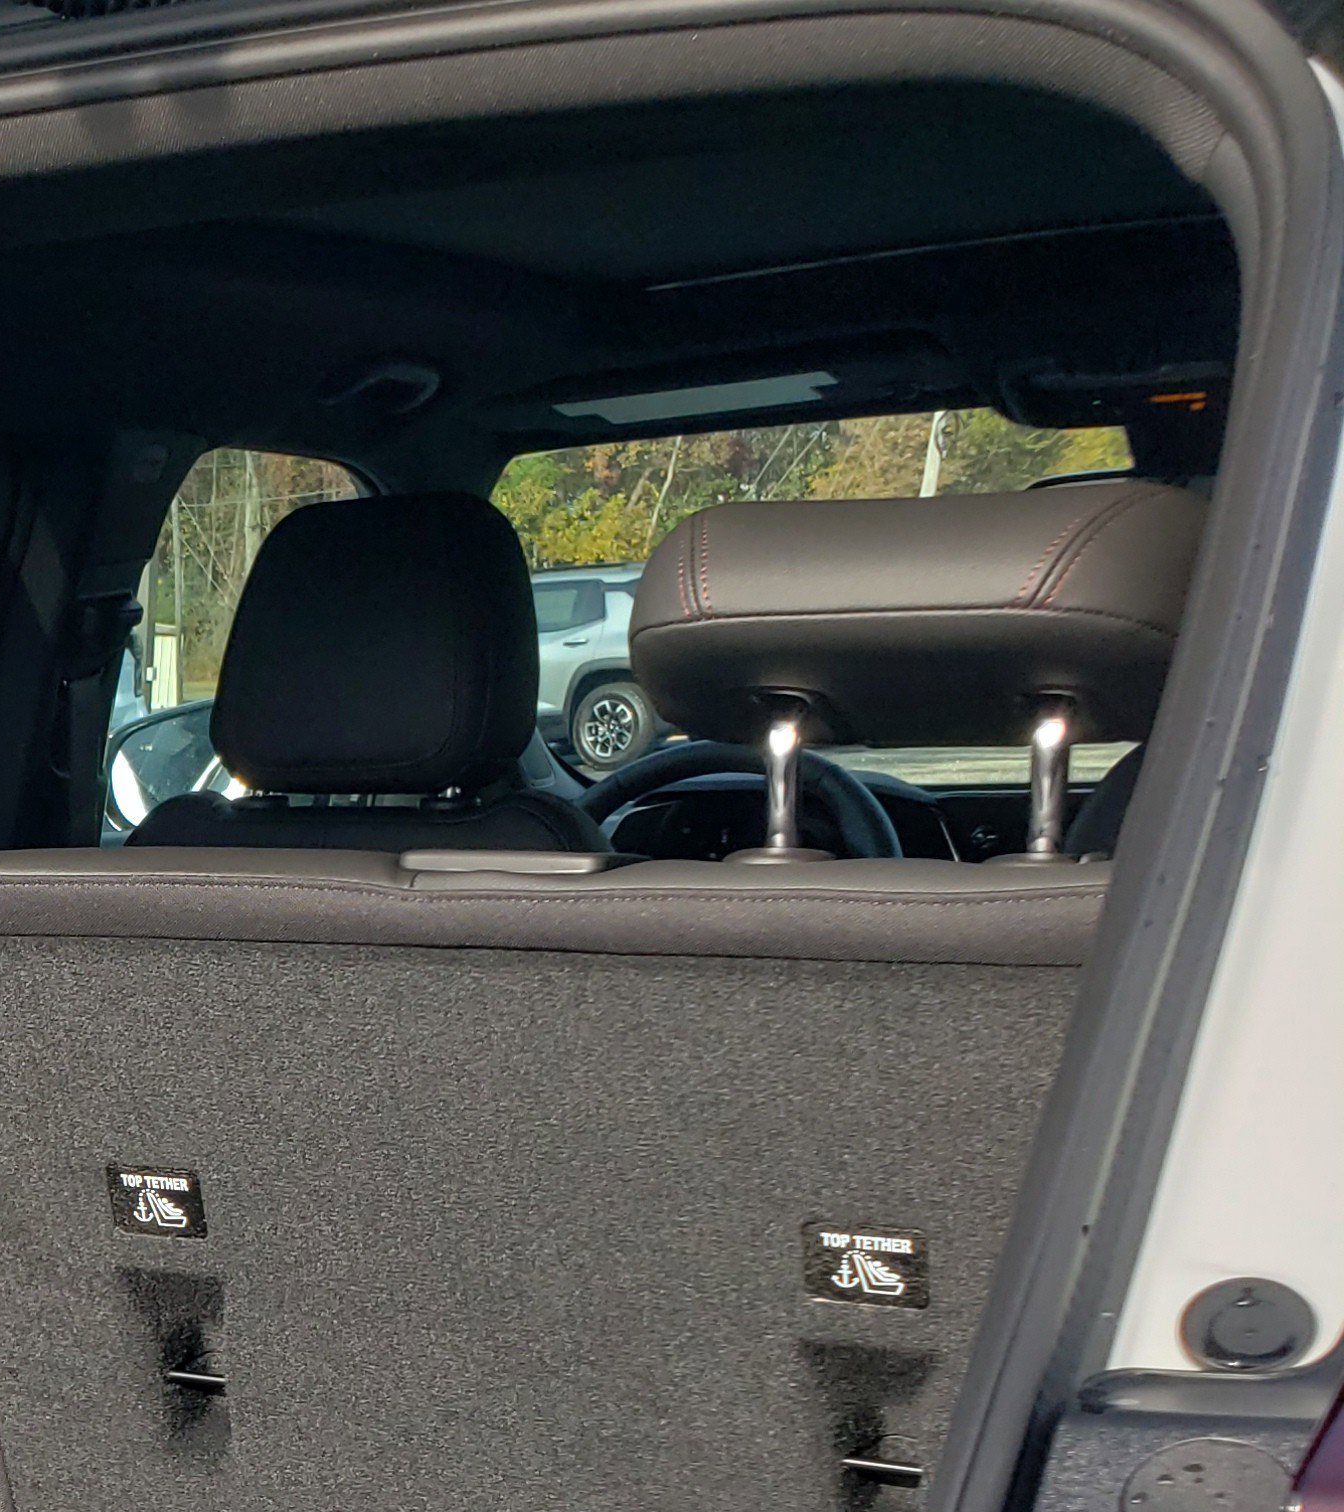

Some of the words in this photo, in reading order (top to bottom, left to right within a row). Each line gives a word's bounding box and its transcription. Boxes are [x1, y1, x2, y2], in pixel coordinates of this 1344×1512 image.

[120, 1173, 143, 1188] TOP
[144, 1175, 189, 1191] TETHER
[820, 1232, 850, 1248] TOP
[852, 1235, 913, 1254] TETHER
